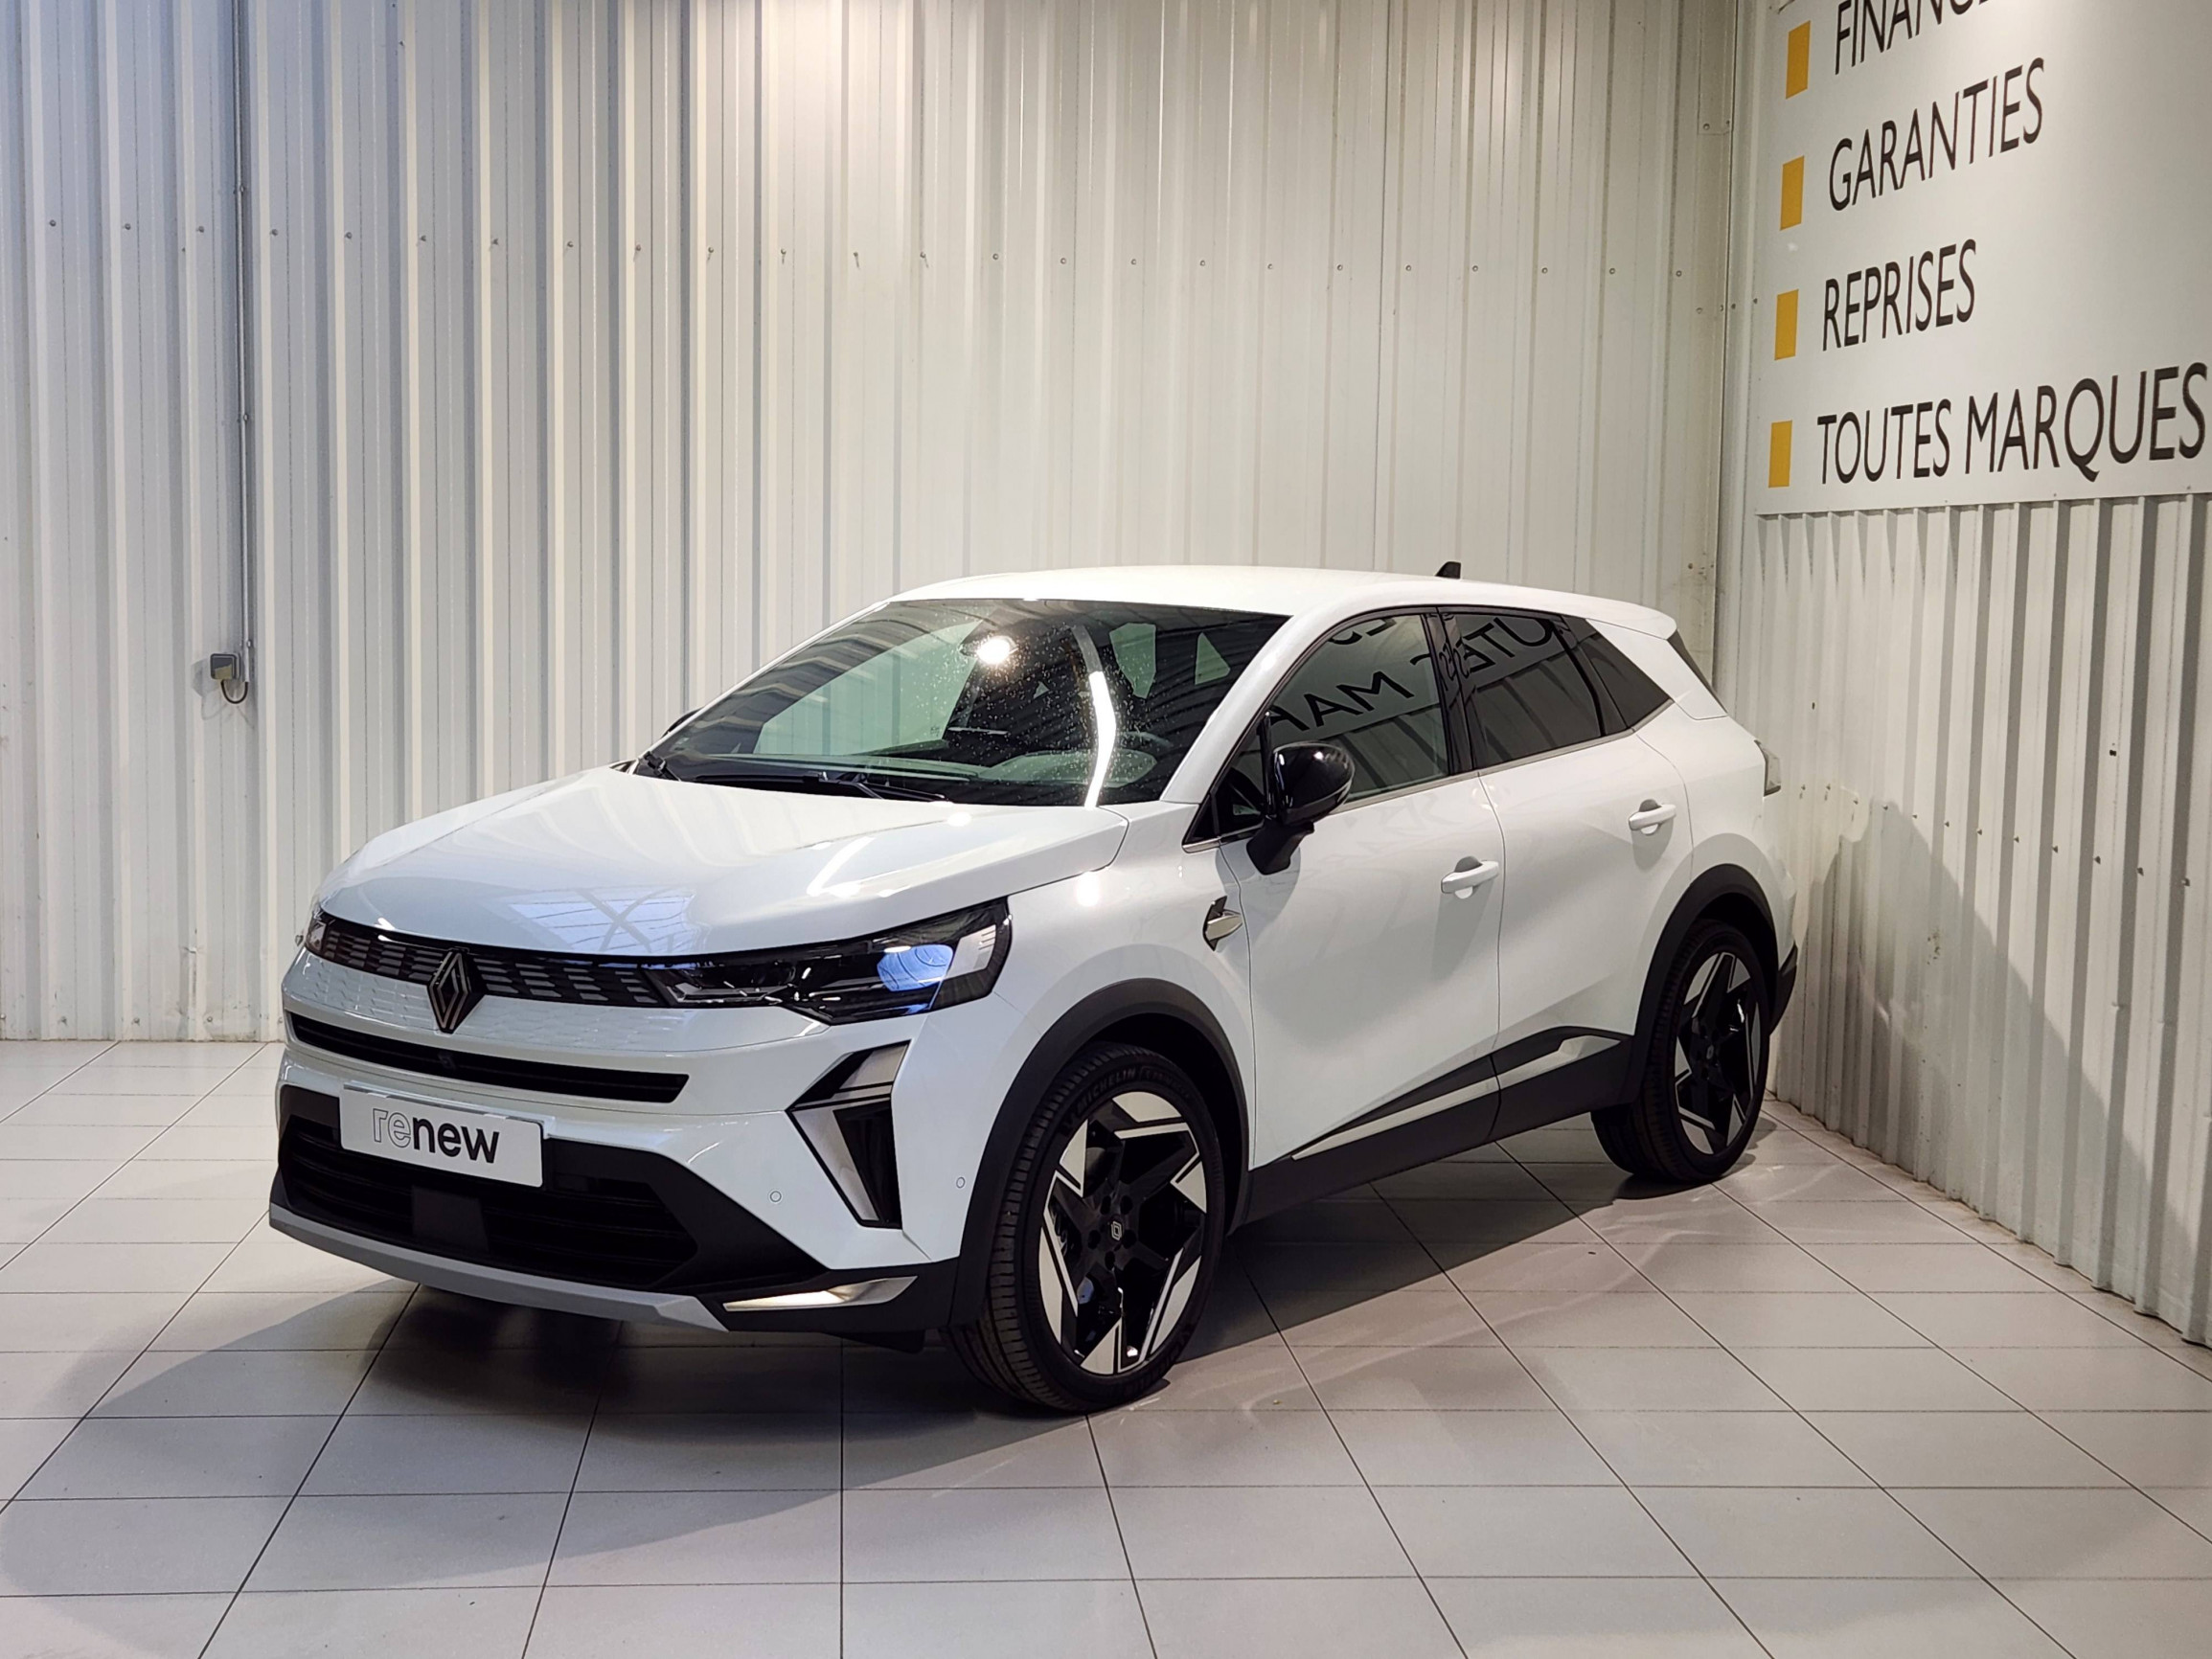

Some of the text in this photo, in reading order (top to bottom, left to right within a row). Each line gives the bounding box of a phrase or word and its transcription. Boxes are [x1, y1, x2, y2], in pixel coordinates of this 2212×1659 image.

[1829, 57, 2044, 211] GARANTIES
[1823, 239, 1976, 351] REPRISES
[1817, 362, 2207, 484] TOUTES MARQUES
[373, 1108, 499, 1163] renew
[1076, 1067, 1137, 1115] MICHELIN
